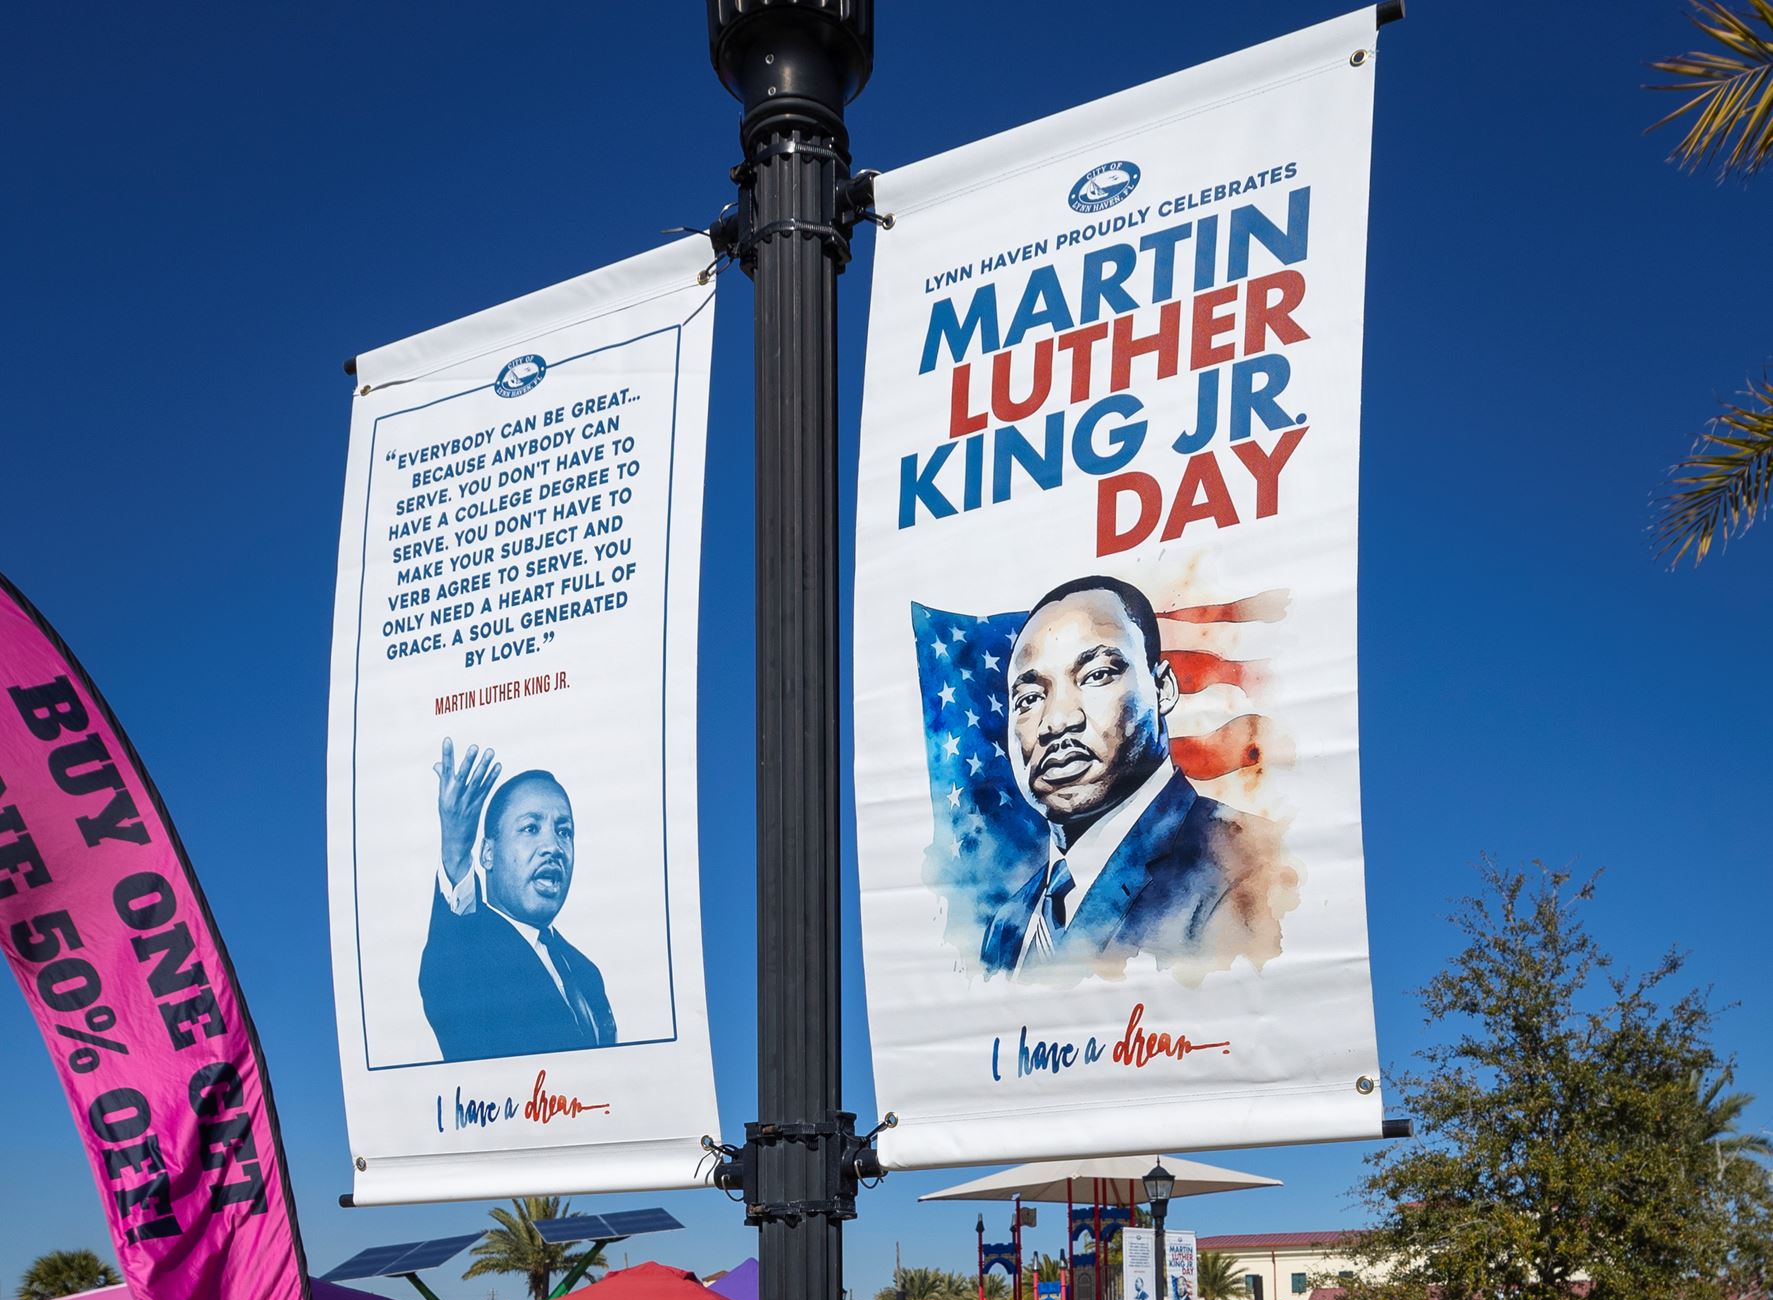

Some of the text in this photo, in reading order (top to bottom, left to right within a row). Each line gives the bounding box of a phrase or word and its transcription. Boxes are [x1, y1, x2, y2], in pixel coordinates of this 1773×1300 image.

[1072, 201, 1092, 213] LYNN
[1086, 162, 1123, 180] CITY OF
[925, 162, 1298, 294] LYNN HAVEN PROUDLY CELEBRATES
[919, 185, 1311, 375] MARTIN
[950, 269, 1311, 440] LUTHER
[500, 415, 536, 439] CAN
[543, 407, 565, 428] BE
[571, 388, 641, 418] GREAT...
[898, 353, 1308, 530] KING JR.
[395, 436, 635, 516] SERVE. YOU DON'T HAVE TO
[412, 415, 620, 488] BECAUSE ANYBODY CAN
[388, 459, 641, 541] HAVE A COLLEGE DEGREE TO
[392, 487, 633, 564] SERVE. YOU DON'T HAVE TO
[1096, 426, 1310, 559] DAY
[387, 537, 632, 611] VERB AGREE TO SERVE. YOU
[397, 515, 624, 587] MAKE YOUR SUBJECT AND
[382, 562, 637, 637] ONLY NEED A HEART FULL OF
[386, 591, 629, 661] GRACE. A SOUL GENERATED
[464, 631, 555, 668] BY LOVE.”
[435, 671, 571, 716] MARTIN LUTHER KING JR.
[7, 675, 269, 1216] BUY ONE GET
[11, 909, 130, 1074] 50%
[88, 1087, 184, 1246] OFF!
[991, 1036, 1002, 1082] I
[1018, 1025, 1080, 1079] have
[1084, 1036, 1107, 1065] a
[437, 1095, 445, 1134] I
[455, 1085, 501, 1131] have
[504, 1096, 520, 1121] a
[1168, 1260, 1186, 1268] KING
[1169, 1245, 1193, 1254] MARTIN
[1171, 1253, 1194, 1261] LUTHER
[1182, 1267, 1195, 1275] DAY
